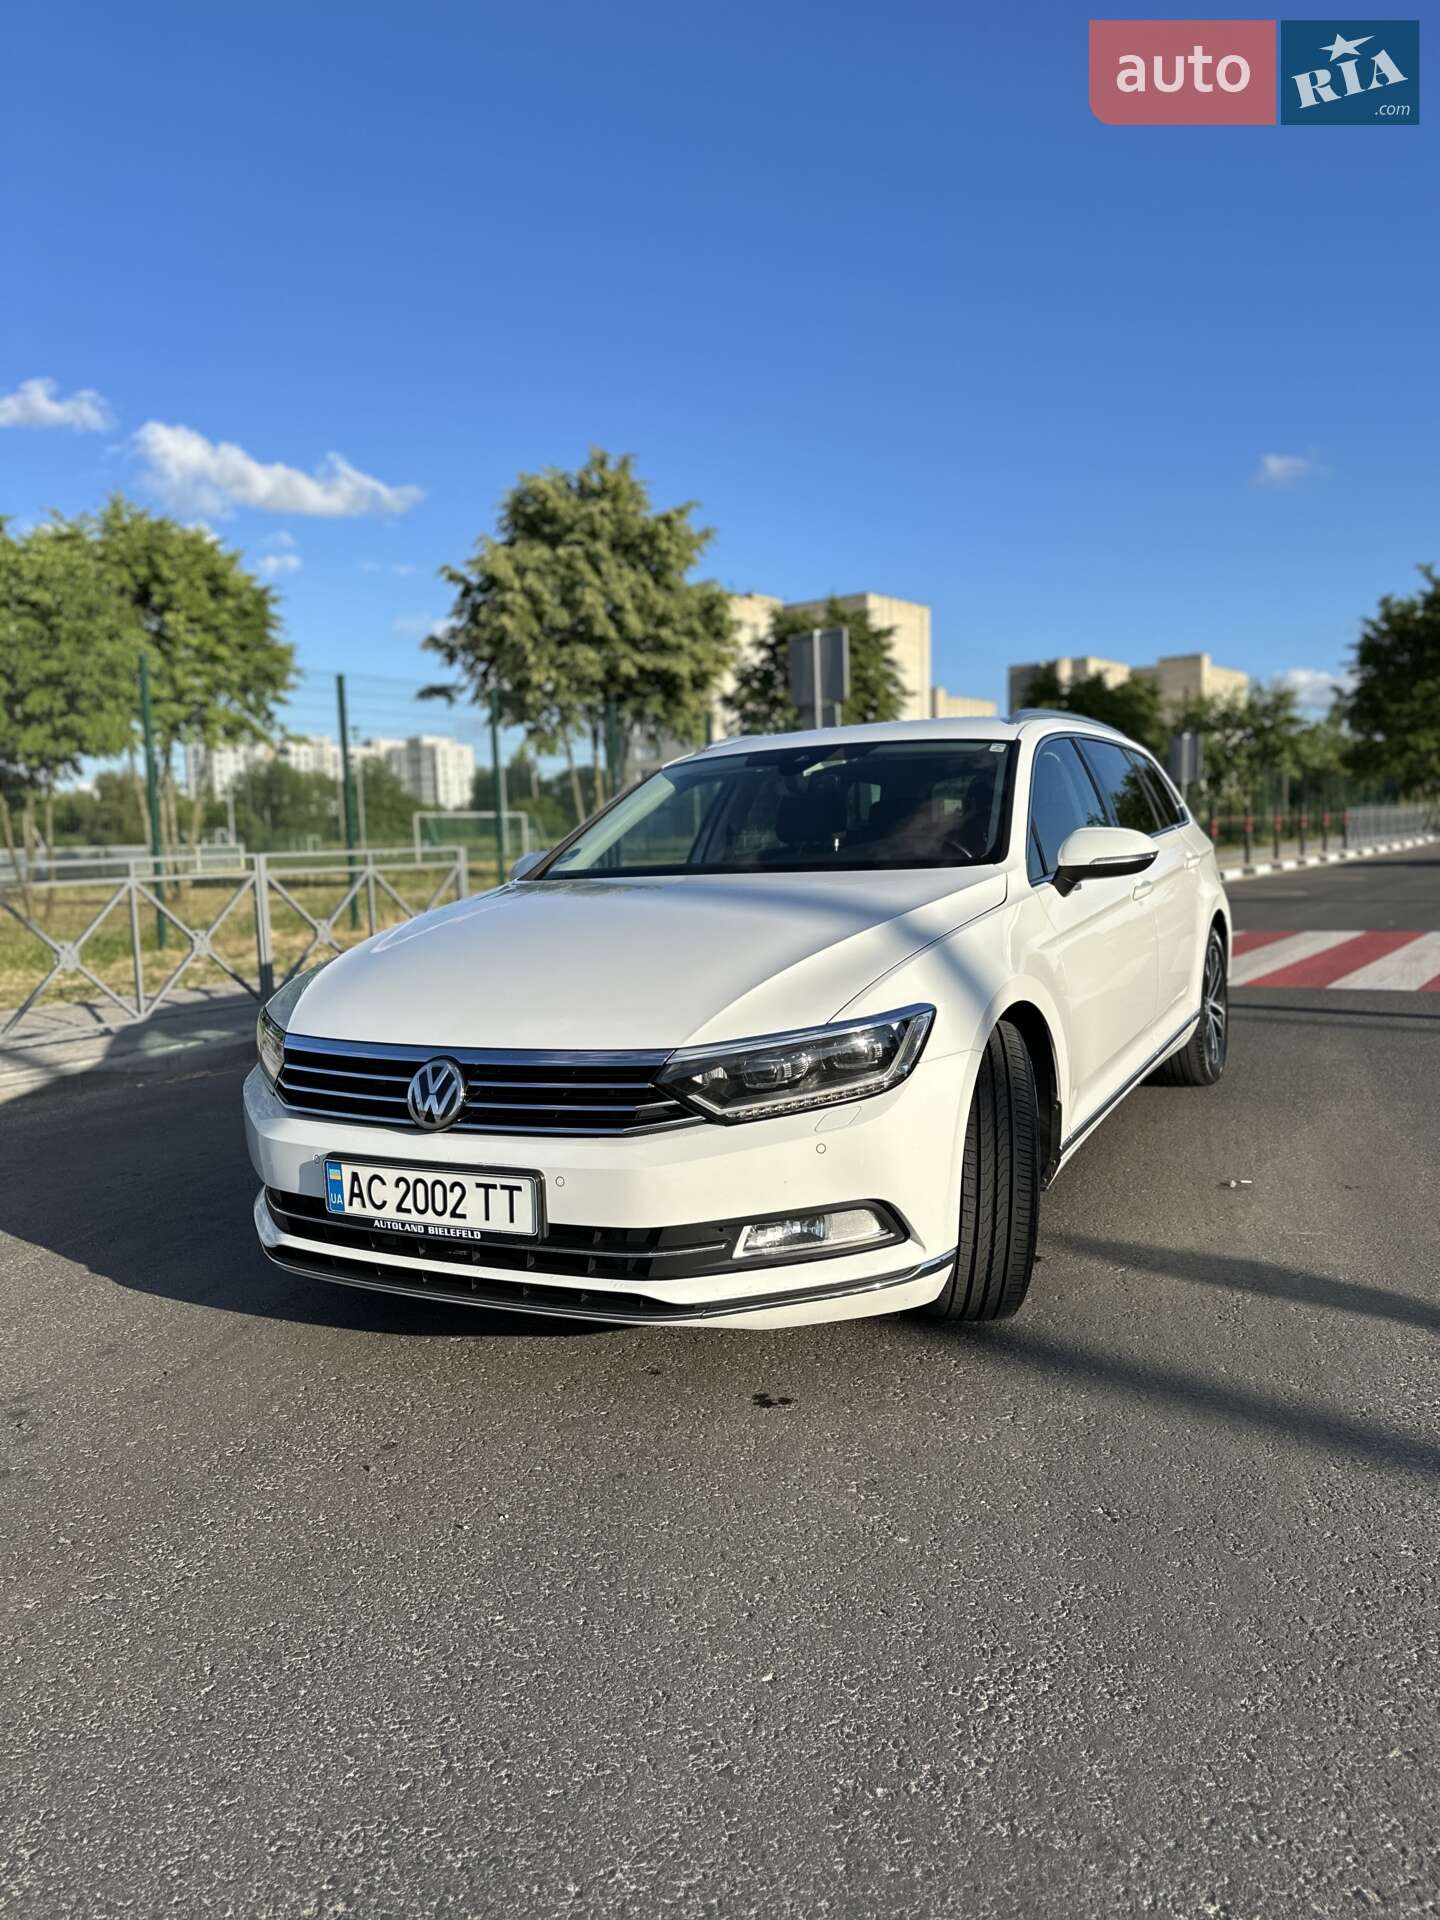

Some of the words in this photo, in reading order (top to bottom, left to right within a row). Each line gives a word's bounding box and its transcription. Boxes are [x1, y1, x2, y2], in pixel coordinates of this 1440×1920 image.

[330, 1194, 344, 1205] UA
[348, 1171, 387, 1210] AC
[394, 1177, 467, 1219] 2002
[475, 1182, 523, 1223] TT
[374, 1219, 425, 1232] AUTOLAND
[428, 1227, 481, 1239] BIELEFELD
